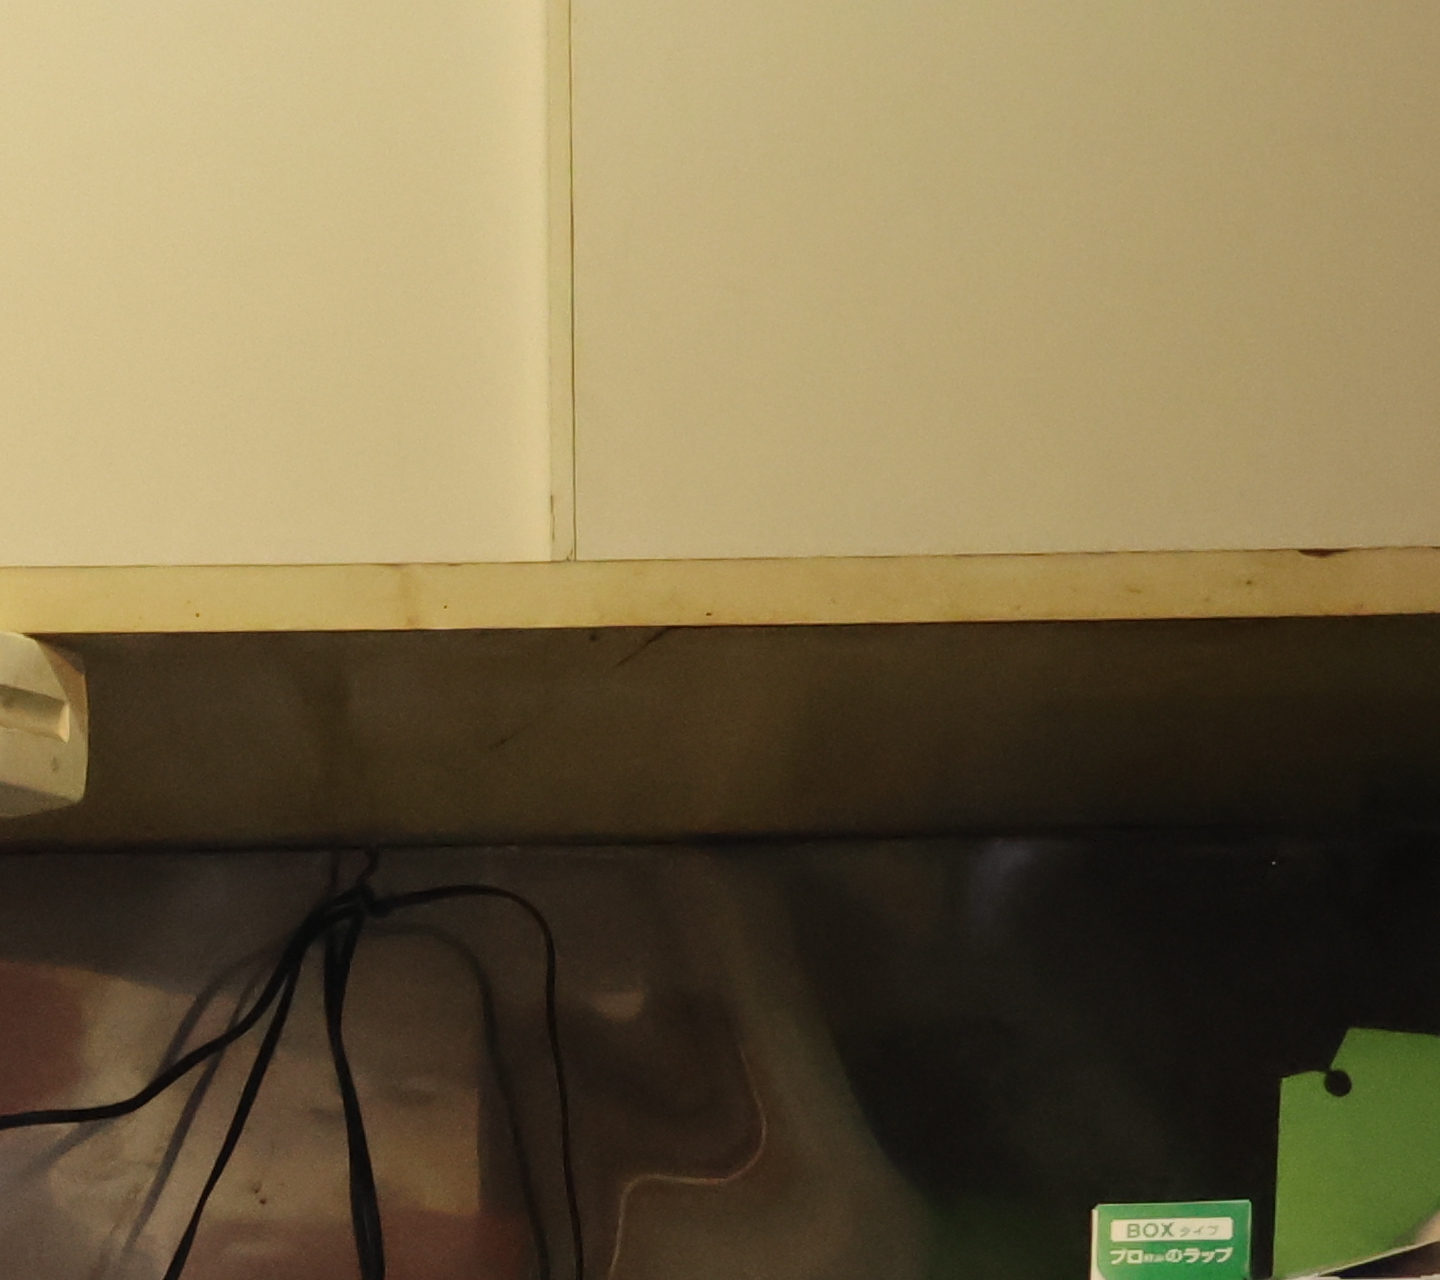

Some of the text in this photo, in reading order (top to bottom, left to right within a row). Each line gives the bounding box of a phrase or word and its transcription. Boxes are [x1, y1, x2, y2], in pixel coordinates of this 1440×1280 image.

[1126, 1222, 1220, 1239] BOX タイプ
